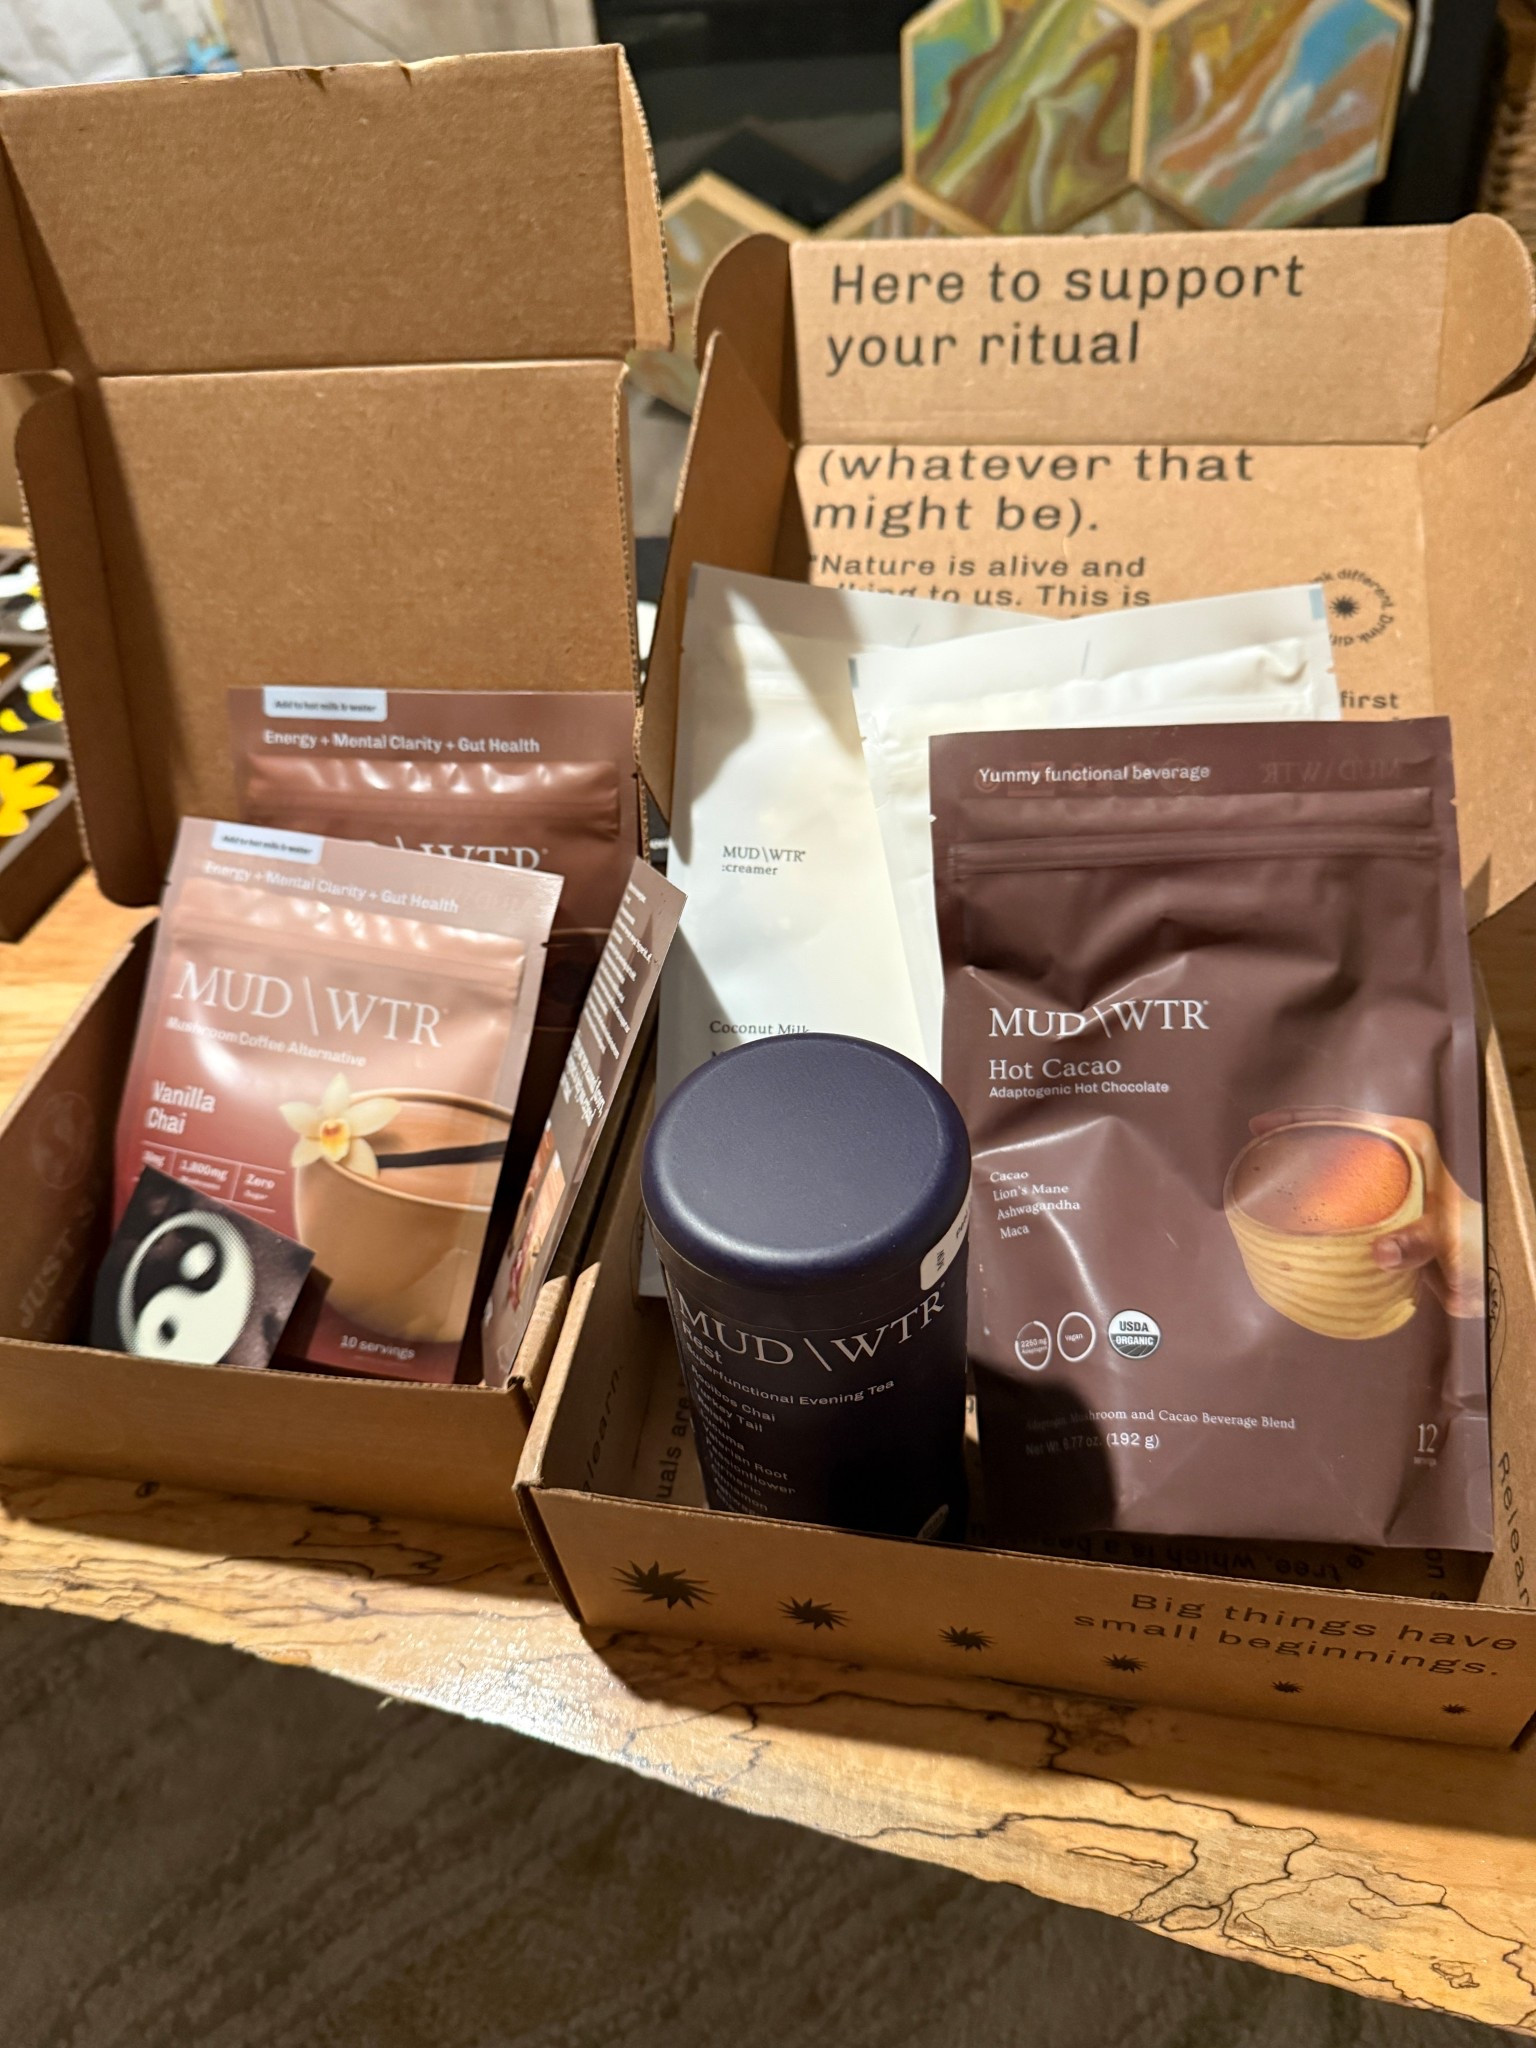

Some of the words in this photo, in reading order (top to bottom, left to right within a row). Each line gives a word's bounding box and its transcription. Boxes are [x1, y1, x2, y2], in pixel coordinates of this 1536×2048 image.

[832, 264, 964, 304] Here
[989, 262, 1041, 302] to
[1065, 255, 1306, 309] support
[826, 333, 957, 377] your
[980, 320, 1139, 365] ritual
[819, 447, 1111, 486] (whatever
[1135, 447, 1254, 481] that
[813, 495, 972, 538] might
[996, 497, 1098, 538] be).
[948, 556, 976, 576] is
[988, 555, 1069, 577] alive
[1081, 556, 1146, 578] and
[929, 587, 960, 604] to
[974, 588, 1022, 607] us.
[1037, 585, 1109, 608] This
[1122, 585, 1151, 607] is
[263, 729, 317, 749] Energy
[332, 732, 386, 749] Mental
[389, 734, 443, 754] Clarity
[458, 737, 486, 752] Gut
[489, 737, 541, 753] Health
[979, 766, 1040, 785] Yummy
[1045, 765, 1129, 782] functional
[1132, 764, 1211, 782] beverage
[203, 860, 250, 882] Energy
[266, 869, 315, 891] Mental
[317, 879, 367, 900] Clarity
[381, 889, 408, 905] Gut
[410, 893, 459, 914] Health
[710, 1020, 773, 1035] Coconut
[165, 1016, 238, 1043] Mushroom
[239, 1031, 285, 1053] Coffee
[287, 1041, 367, 1067] Alternative
[988, 1059, 1033, 1080] Hot
[1042, 1058, 1121, 1080] Cacao
[152, 1080, 217, 1113] Vanilla
[989, 1083, 1071, 1098] Adaptogenic
[1075, 1082, 1098, 1095] Hot
[1101, 1081, 1170, 1094] Chocolate
[144, 1107, 187, 1134] Chai
[244, 1173, 276, 1190] Zero
[989, 1171, 1029, 1182] Cacao
[993, 1185, 1028, 1201] Lion's
[1032, 1184, 1069, 1194] Mane
[997, 1200, 1081, 1220] Ashwagandha
[1000, 1225, 1030, 1239] Maca
[1119, 1320, 1149, 1332] USDA
[340, 1335, 358, 1348] 10
[359, 1340, 416, 1360] servings
[682, 1321, 722, 1365] Rest
[1115, 1335, 1154, 1346] ORGANIC
[800, 1389, 864, 1405] Evening
[868, 1380, 895, 1396] Tea
[737, 1414, 762, 1432] Tail
[742, 1403, 775, 1422] Chai
[1131, 1409, 1154, 1420] and
[1159, 1410, 1198, 1422] Cacao
[1202, 1412, 1257, 1428] Beverage
[1261, 1416, 1295, 1429] Blend
[656, 1447, 681, 1498] uals
[671, 1397, 690, 1437] are
[1106, 1432, 1140, 1447] (192
[1144, 1433, 1160, 1449] g)
[1417, 1423, 1438, 1453] 12
[755, 1463, 789, 1480] Root
[1498, 1452, 1531, 1607] Relear
[1130, 1594, 1204, 1619] Big
[1224, 1605, 1378, 1638] things
[1397, 1624, 1518, 1652] have
[1073, 1613, 1198, 1641] small
[1218, 1630, 1499, 1676] beginnings.
